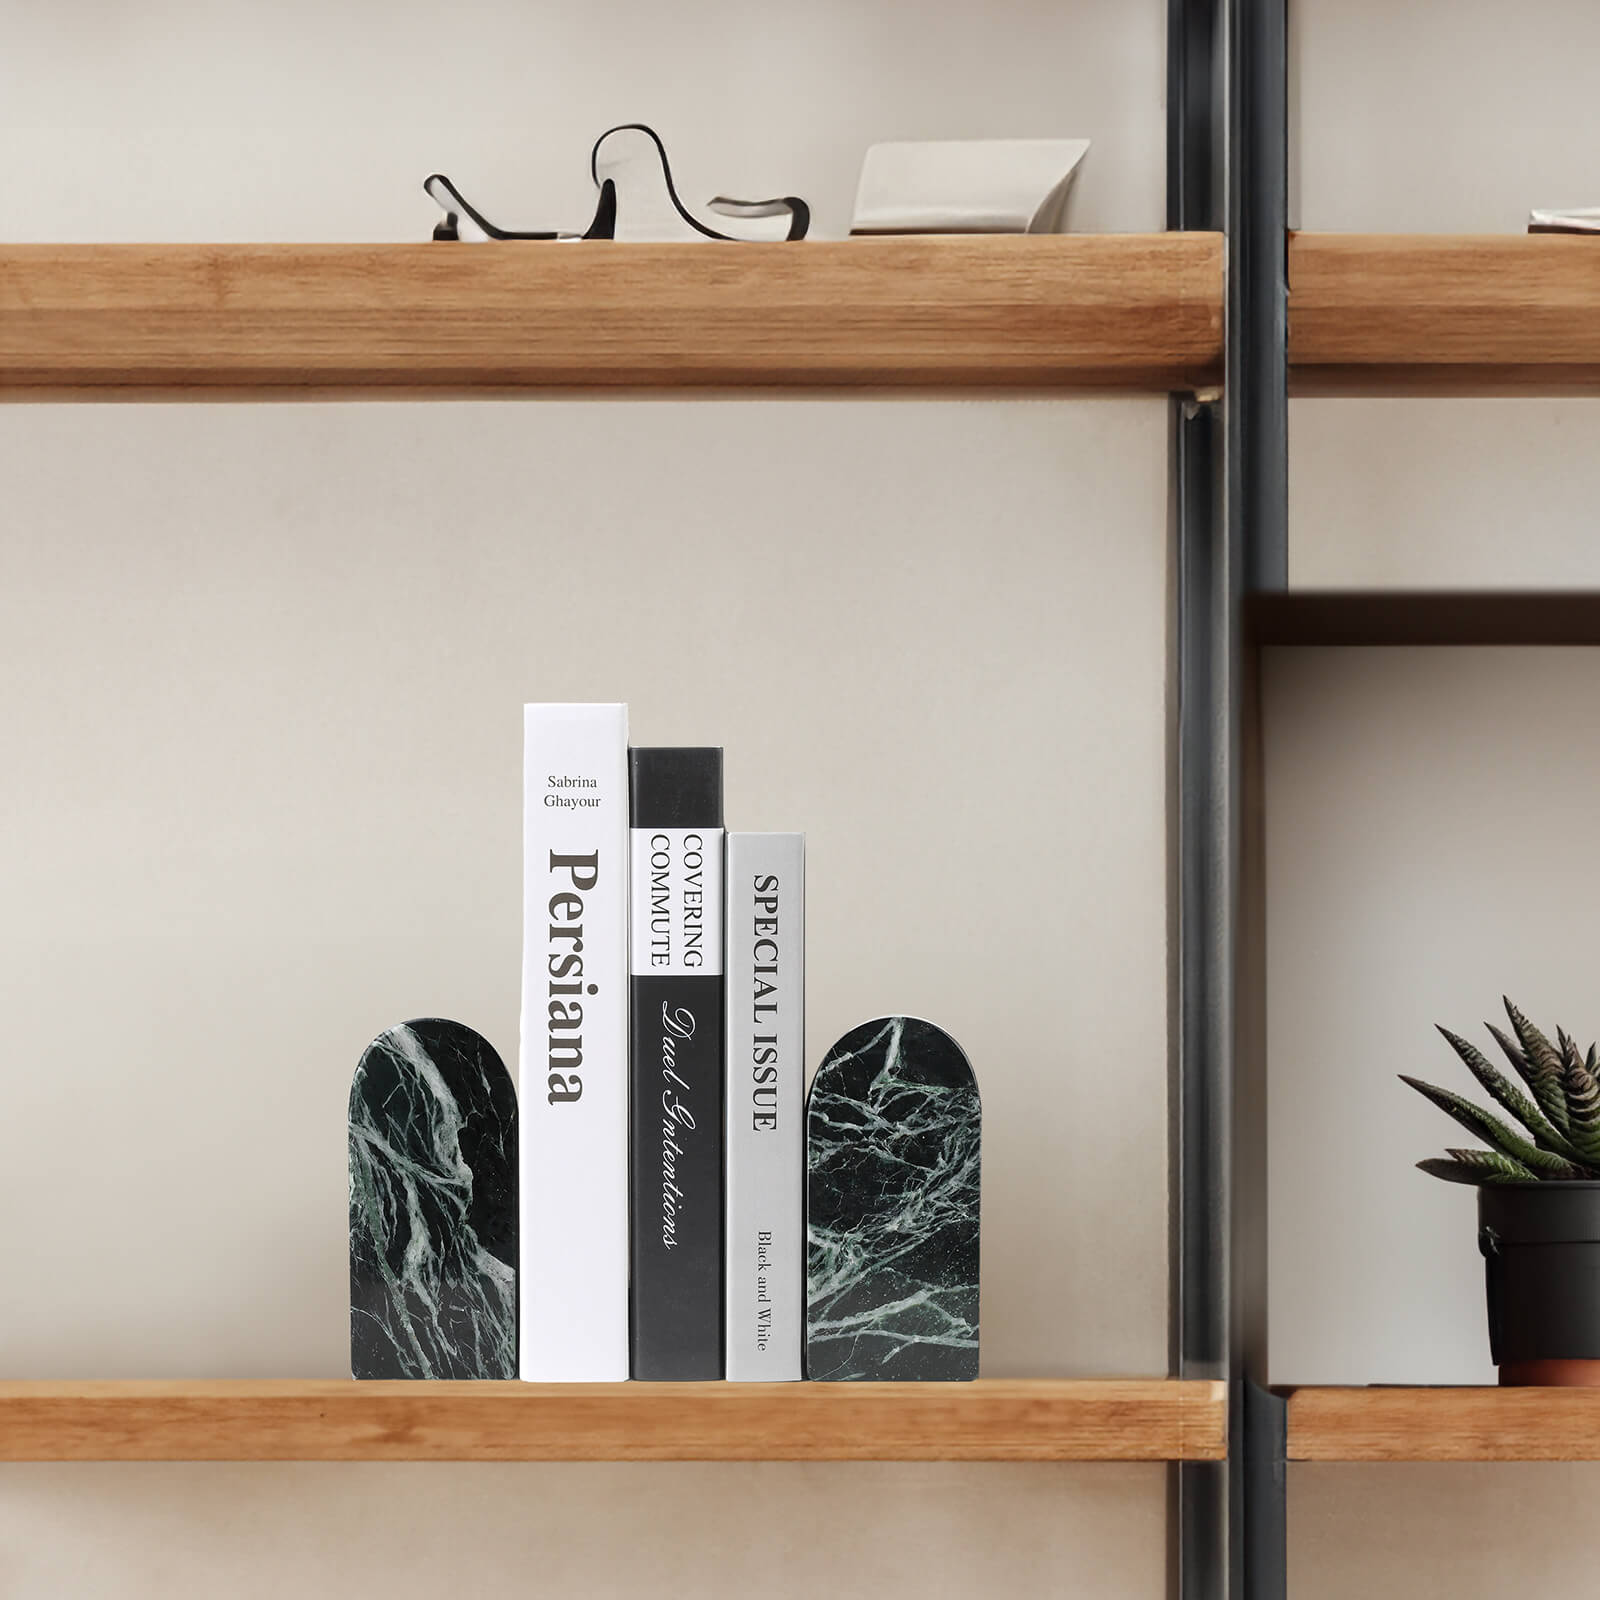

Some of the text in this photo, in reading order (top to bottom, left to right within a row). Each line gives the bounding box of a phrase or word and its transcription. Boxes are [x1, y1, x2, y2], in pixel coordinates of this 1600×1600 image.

[544, 795, 601, 810] Ghayour
[548, 776, 597, 788] Sabrina
[651, 834, 670, 966] COMMUTE
[684, 834, 703, 968] COVERING
[548, 849, 598, 1106] Persiana
[753, 875, 778, 1131] SPECIAL ISSUE
[663, 1001, 695, 1249] Duel Intentions
[758, 1232, 771, 1350] Black and White
